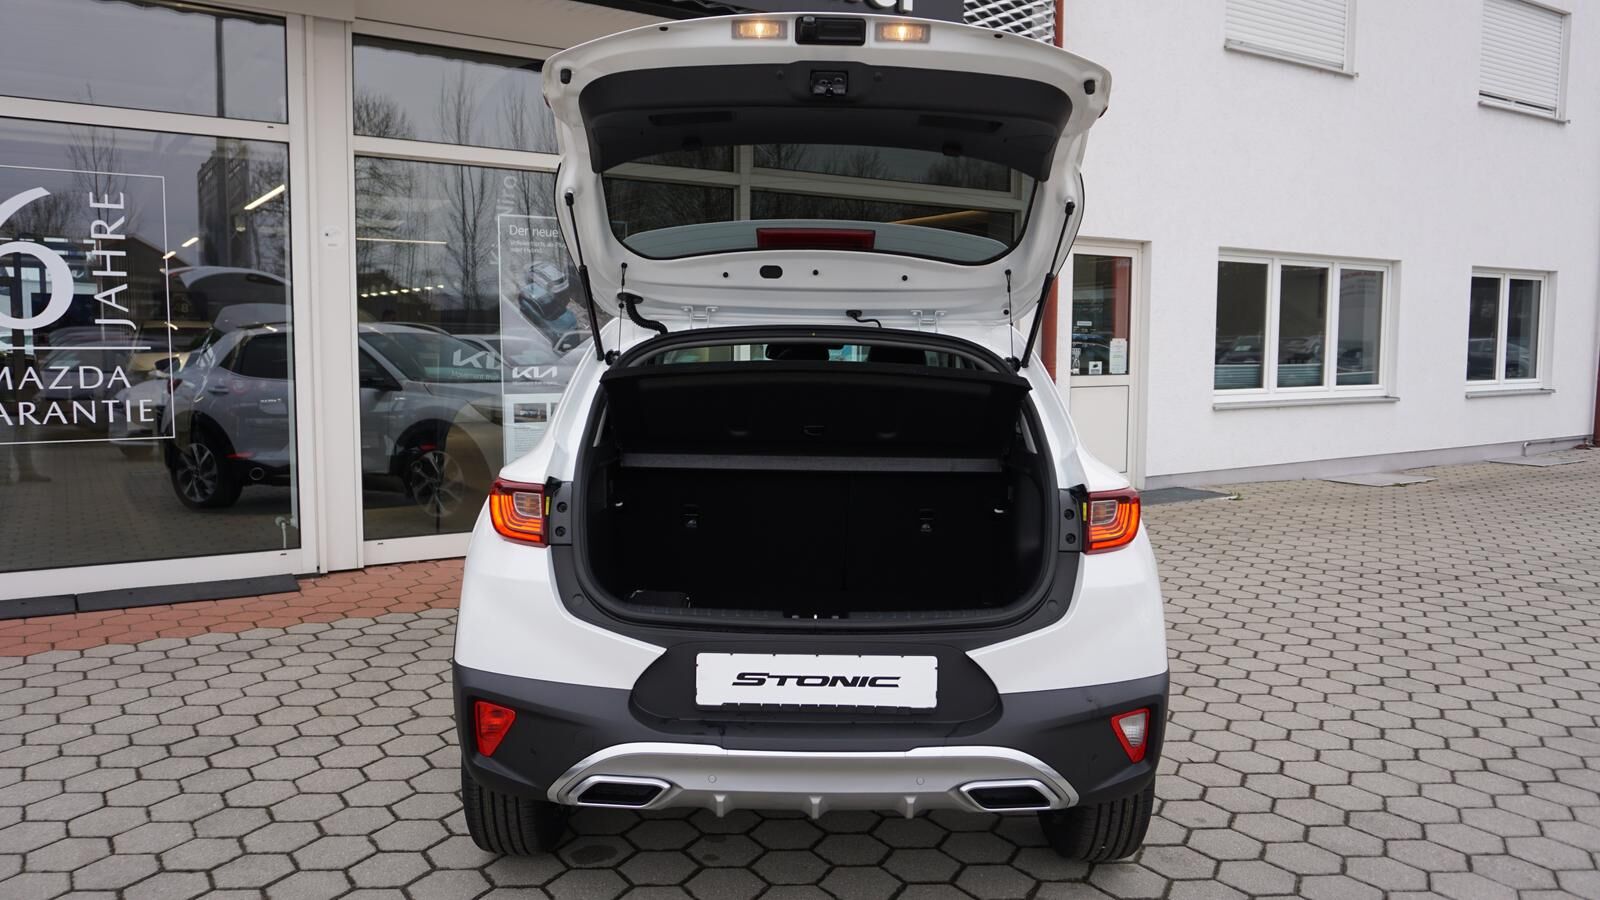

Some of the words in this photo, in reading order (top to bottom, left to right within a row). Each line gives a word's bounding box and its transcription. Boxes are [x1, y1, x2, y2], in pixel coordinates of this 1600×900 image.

[509, 225, 529, 236] Der
[532, 228, 559, 238] neue
[89, 191, 137, 330] JAHRE
[453, 349, 501, 369] KI
[731, 672, 901, 688] STONIC
